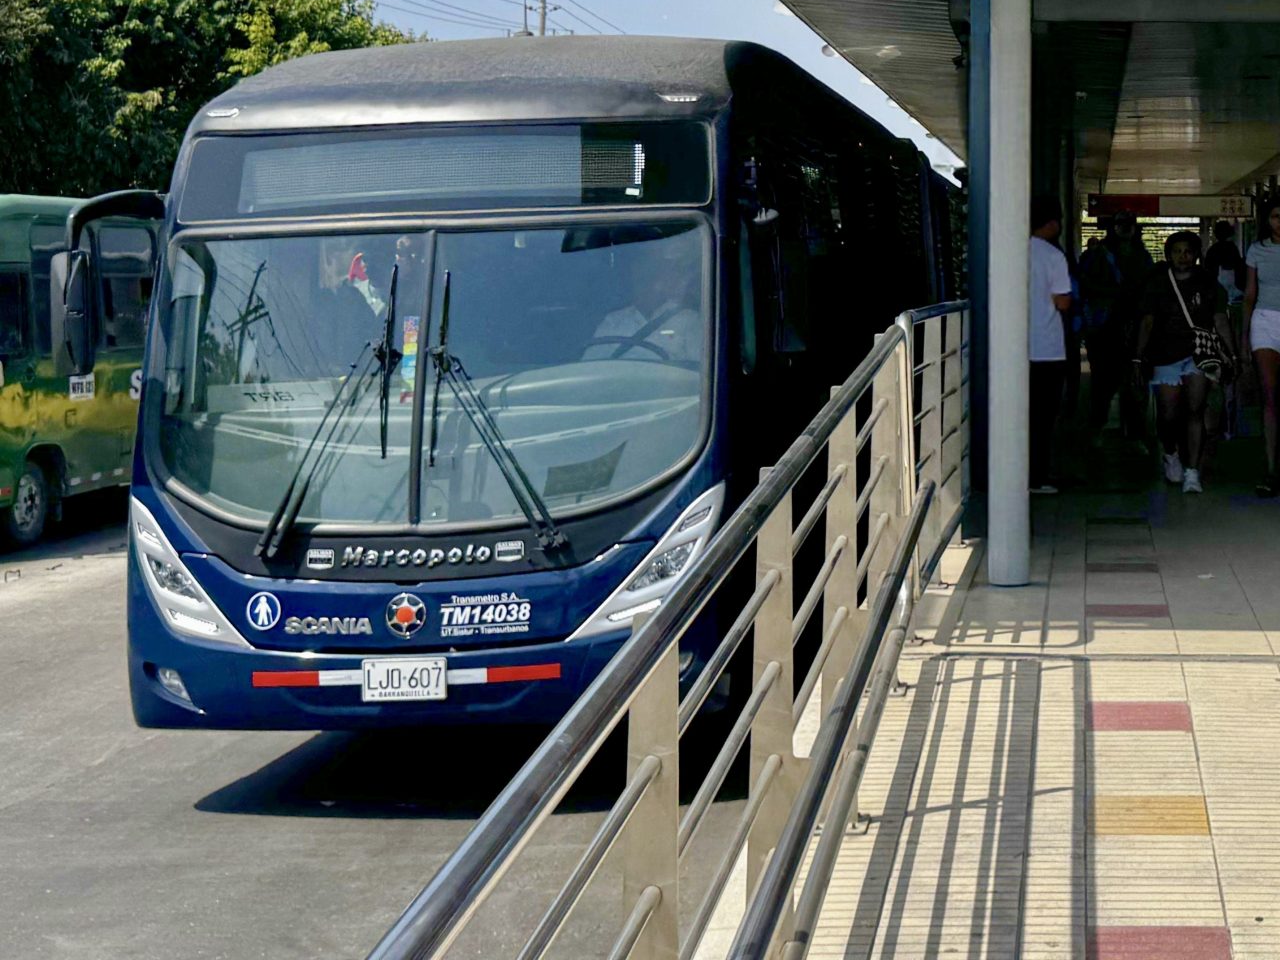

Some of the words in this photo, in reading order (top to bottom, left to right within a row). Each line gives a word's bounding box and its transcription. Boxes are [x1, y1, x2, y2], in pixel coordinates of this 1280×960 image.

[340, 544, 492, 568] Marcopolo
[451, 593, 500, 605] Transmetro
[440, 603, 532, 626] TM14038
[284, 616, 374, 635] SCANIA
[378, 690, 431, 698] BARRANQUILLA
